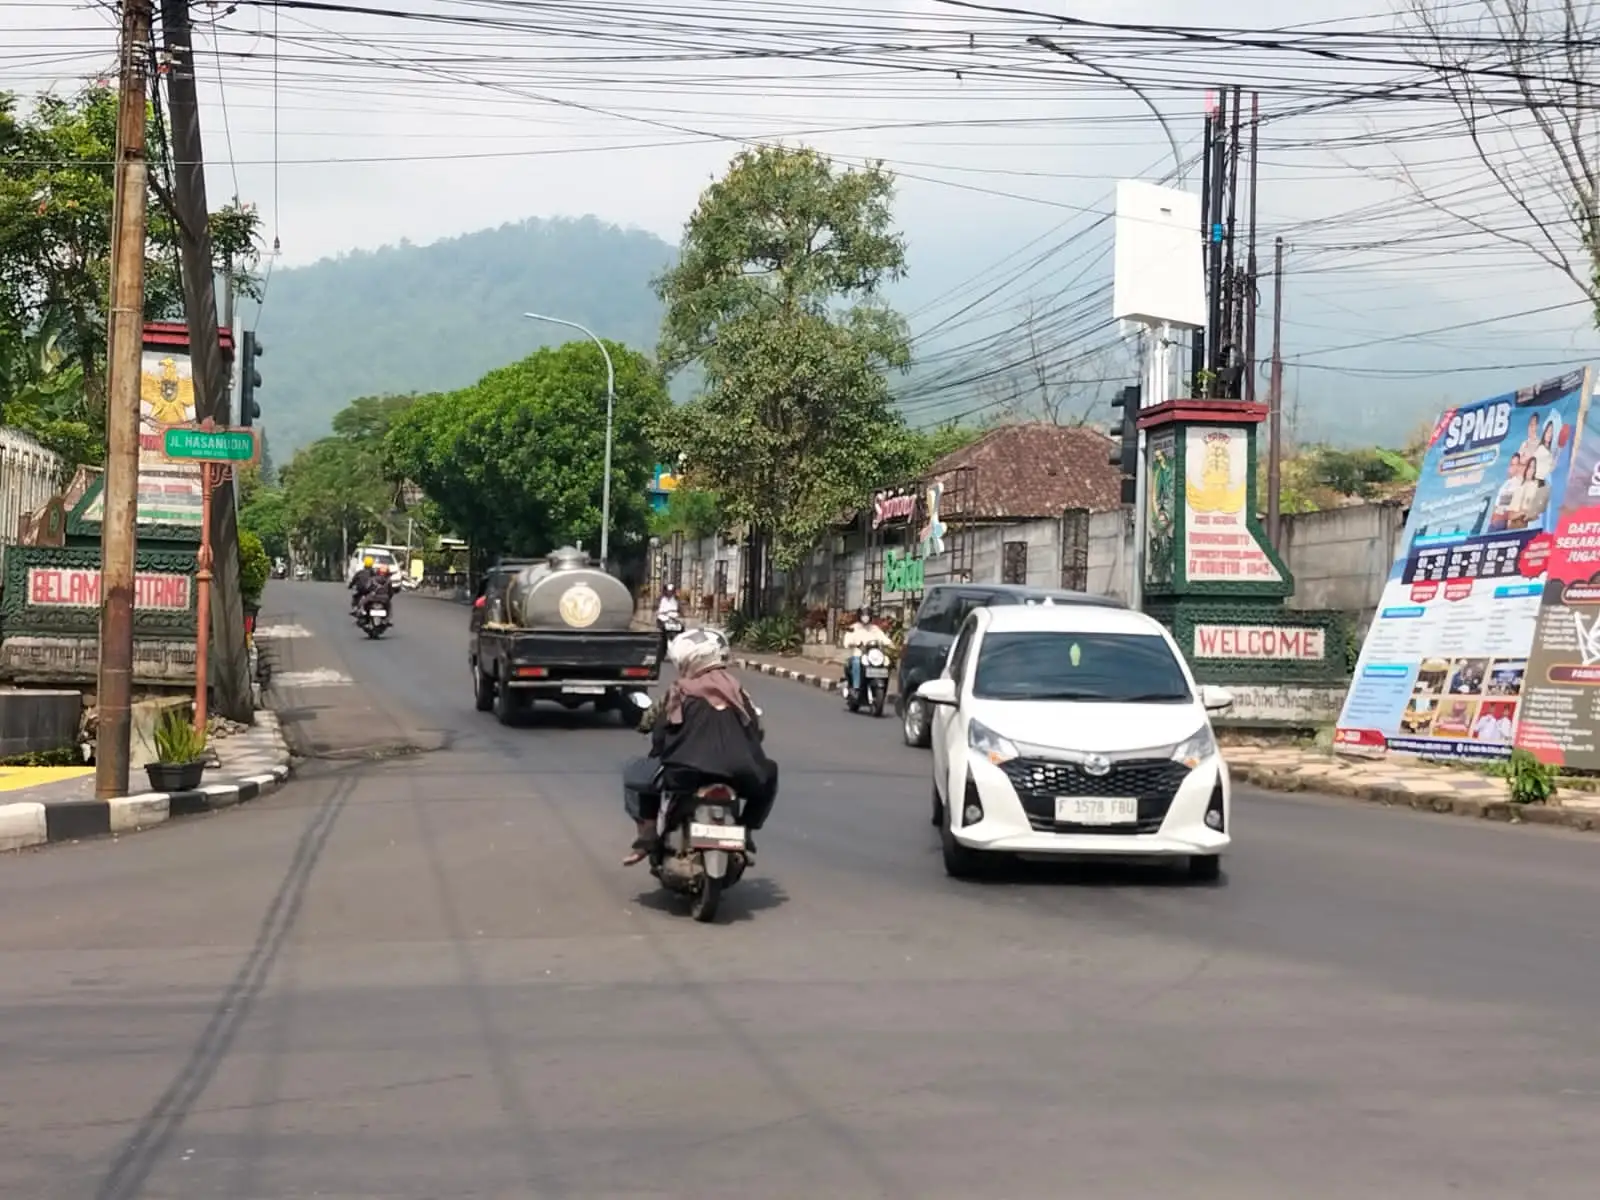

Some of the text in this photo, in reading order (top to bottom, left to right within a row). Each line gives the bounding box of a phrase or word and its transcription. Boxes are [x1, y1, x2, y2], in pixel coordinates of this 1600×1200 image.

[1446, 402, 1511, 448] SPMB
[184, 435, 250, 451] HASANUDIN
[1199, 629, 1319, 657] WELCOME
[1059, 800, 1066, 813] F
